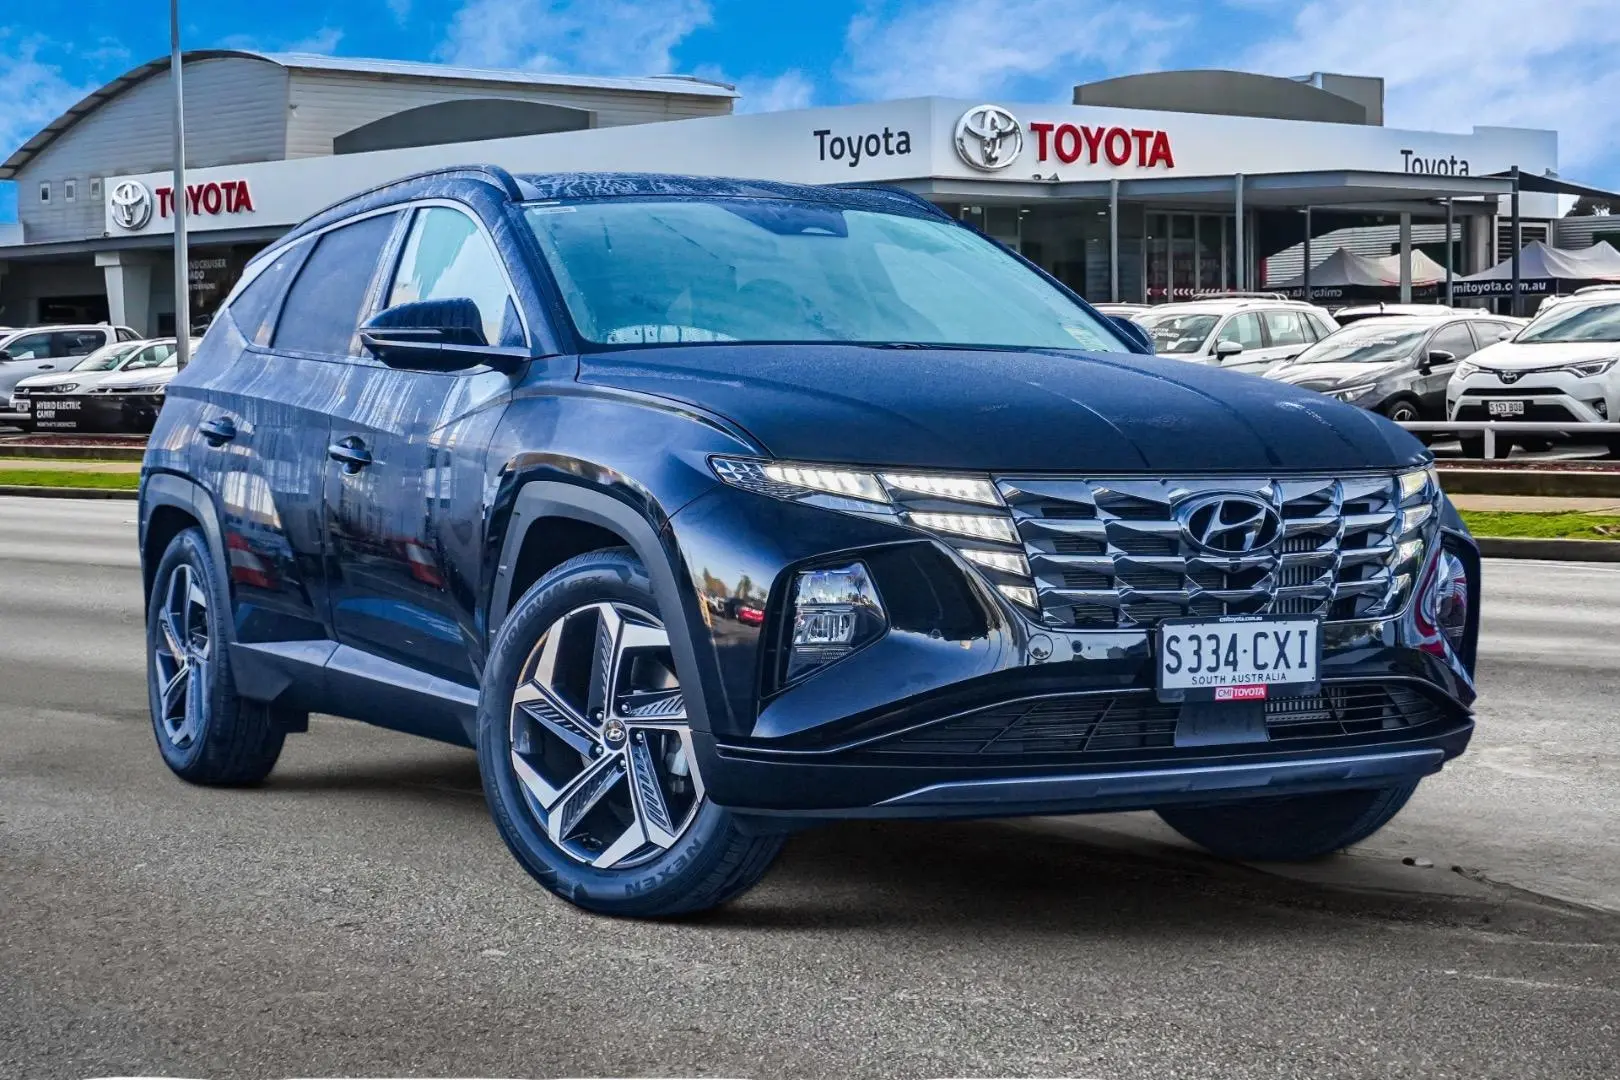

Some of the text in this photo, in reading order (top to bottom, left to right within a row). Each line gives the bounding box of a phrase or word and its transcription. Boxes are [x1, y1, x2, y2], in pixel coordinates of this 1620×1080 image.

[813, 127, 912, 167] Toyota
[1030, 122, 1175, 168] TOYOTA
[1452, 281, 1547, 295] mitoyota.cm.au
[56, 401, 81, 409] ELECTRIC
[1192, 672, 1287, 685] SOUTH AUSTRALIA
[1233, 687, 1265, 697] TOYOTA
[624, 837, 702, 897] NEXEN
